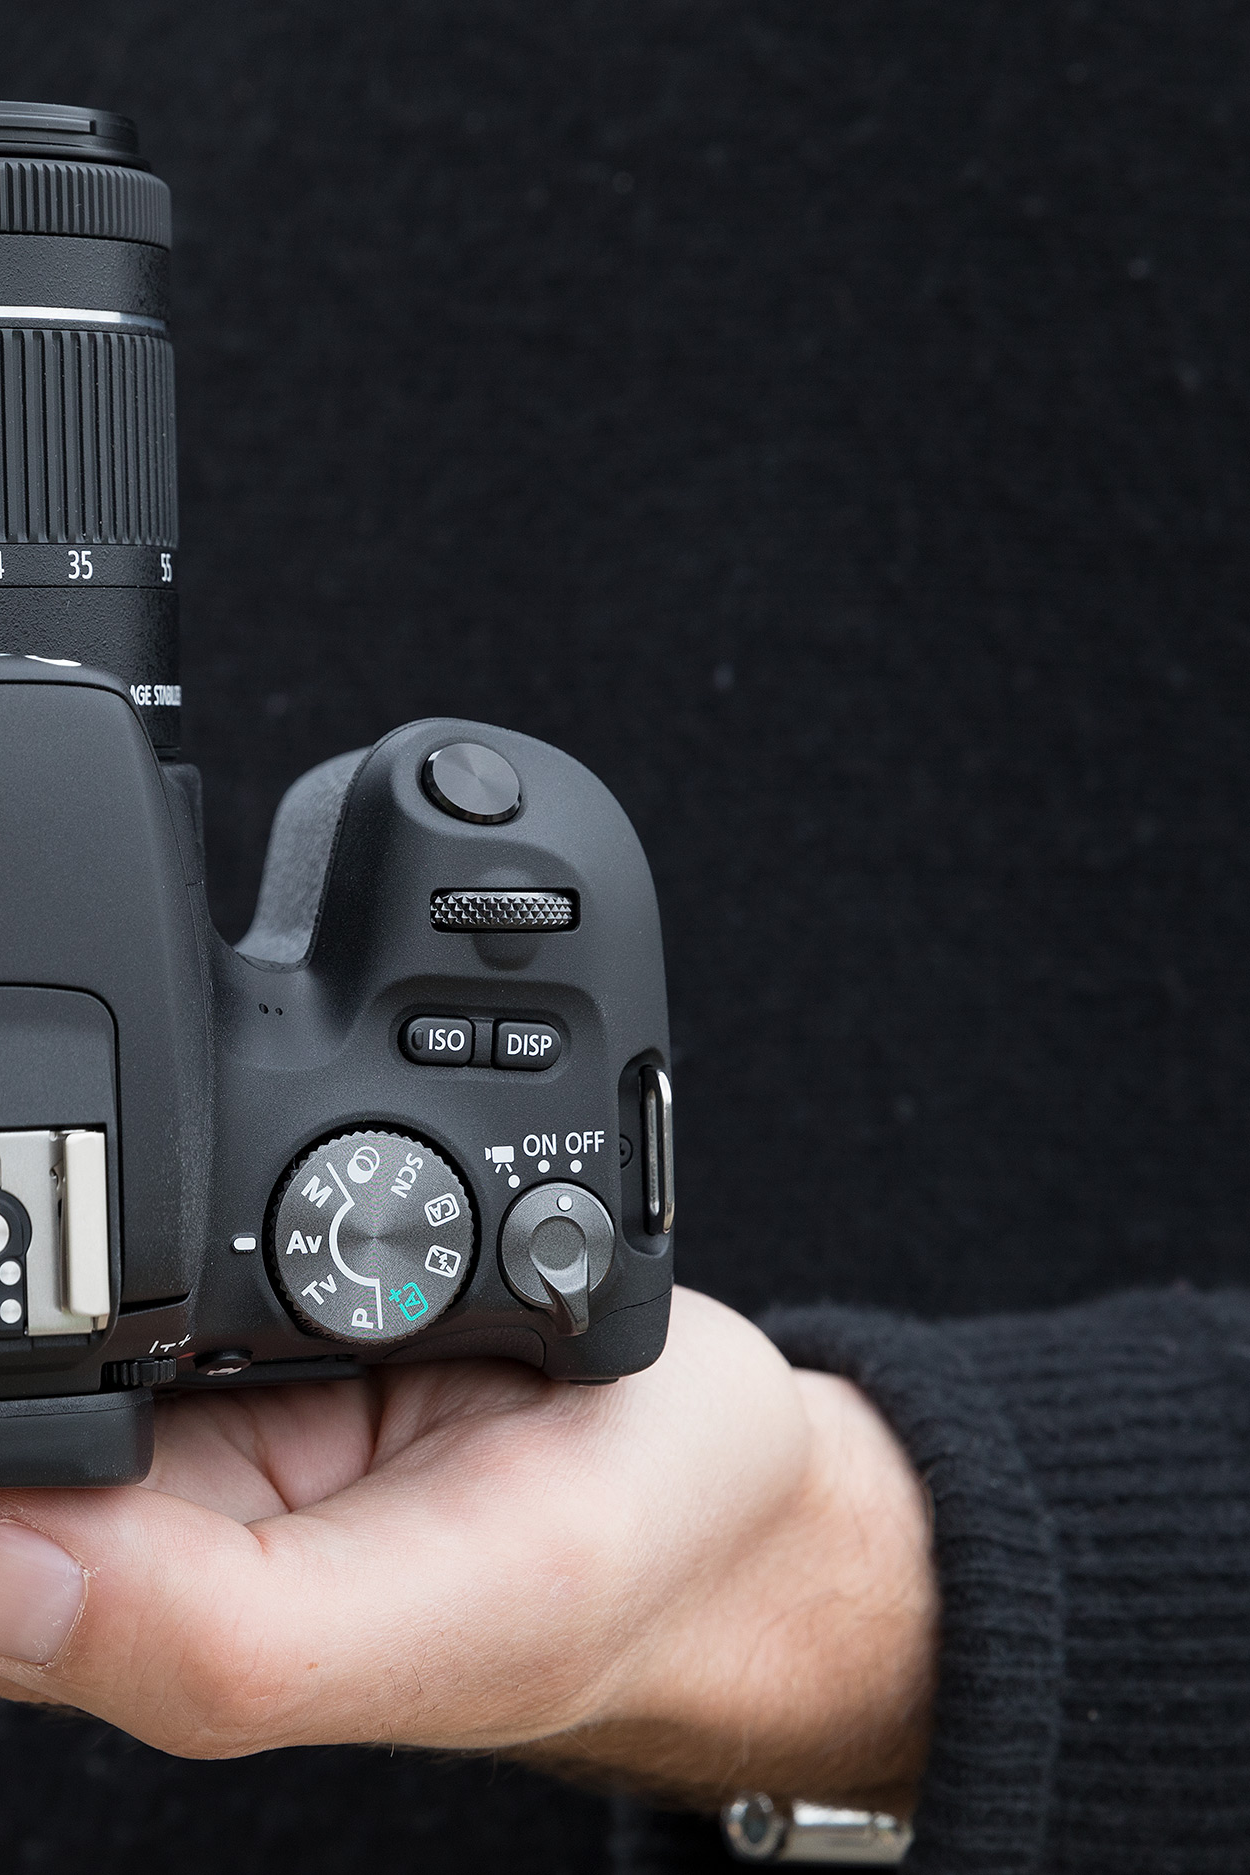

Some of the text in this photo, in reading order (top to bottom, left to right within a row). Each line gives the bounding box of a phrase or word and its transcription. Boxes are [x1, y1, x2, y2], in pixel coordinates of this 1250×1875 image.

[67, 550, 94, 580] 35
[160, 553, 172, 583] 55
[428, 1028, 465, 1052] ISO
[507, 1033, 553, 1057] DISP
[522, 1130, 605, 1157] ON OFF
[390, 1152, 424, 1199] SCN
[301, 1175, 333, 1209] M
[286, 1230, 322, 1255] Av
[301, 1273, 338, 1306] Tv
[351, 1307, 374, 1330] P
